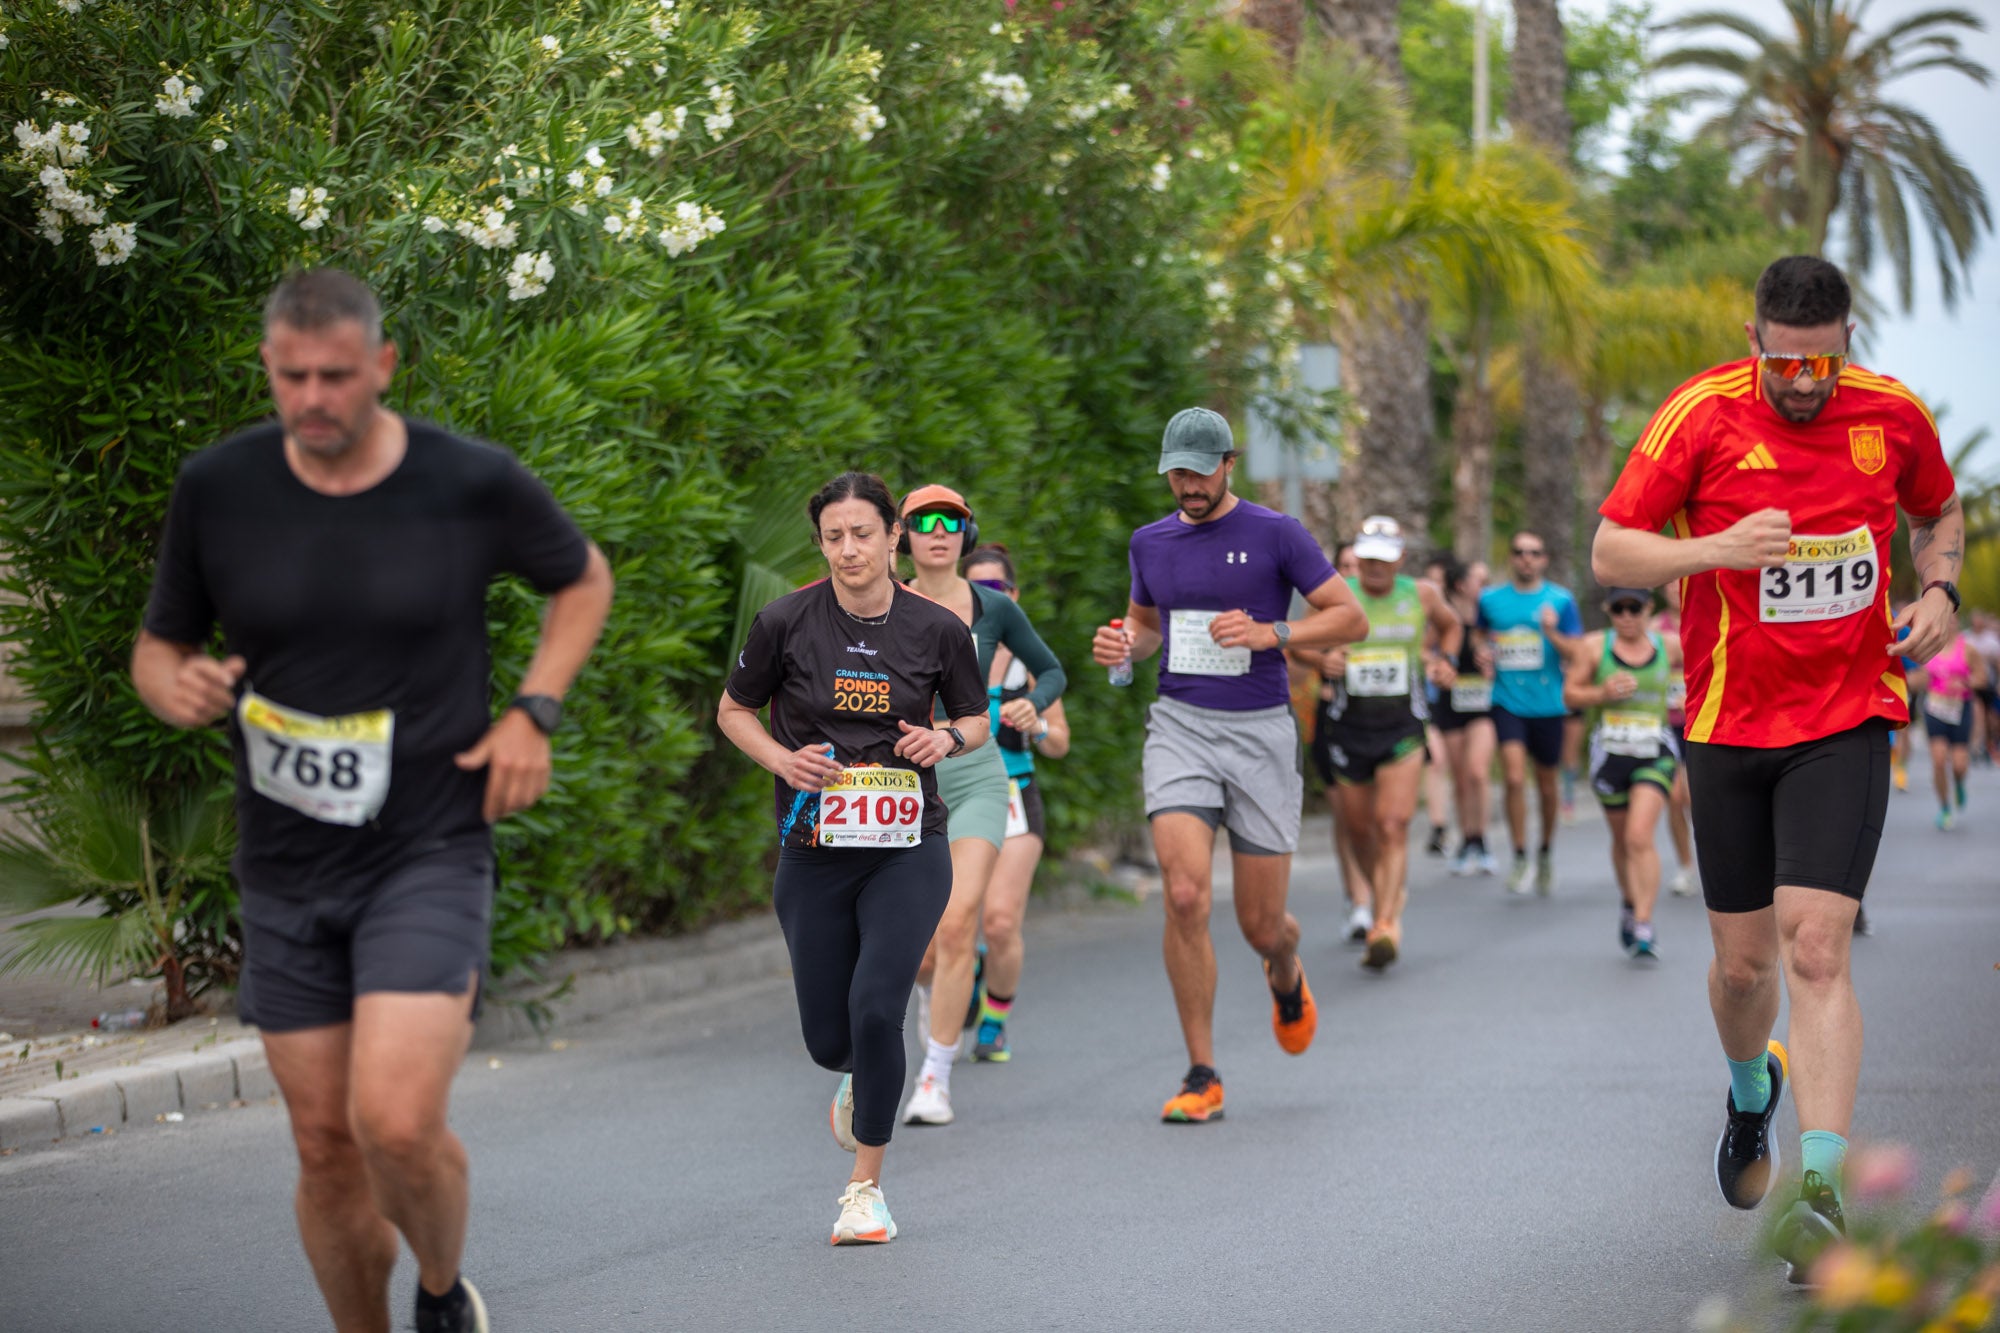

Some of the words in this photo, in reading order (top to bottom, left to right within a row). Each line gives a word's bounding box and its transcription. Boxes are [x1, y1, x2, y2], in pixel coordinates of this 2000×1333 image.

[1797, 543, 1856, 557] FONDO
[1765, 560, 1873, 599] 3119
[835, 669, 858, 678] GRAN
[859, 671, 889, 680] PREMIO
[834, 678, 891, 695] FONDO
[833, 691, 891, 714] 2025
[265, 736, 361, 790] 768
[853, 776, 902, 787] FONDO
[823, 795, 920, 825] 2109
